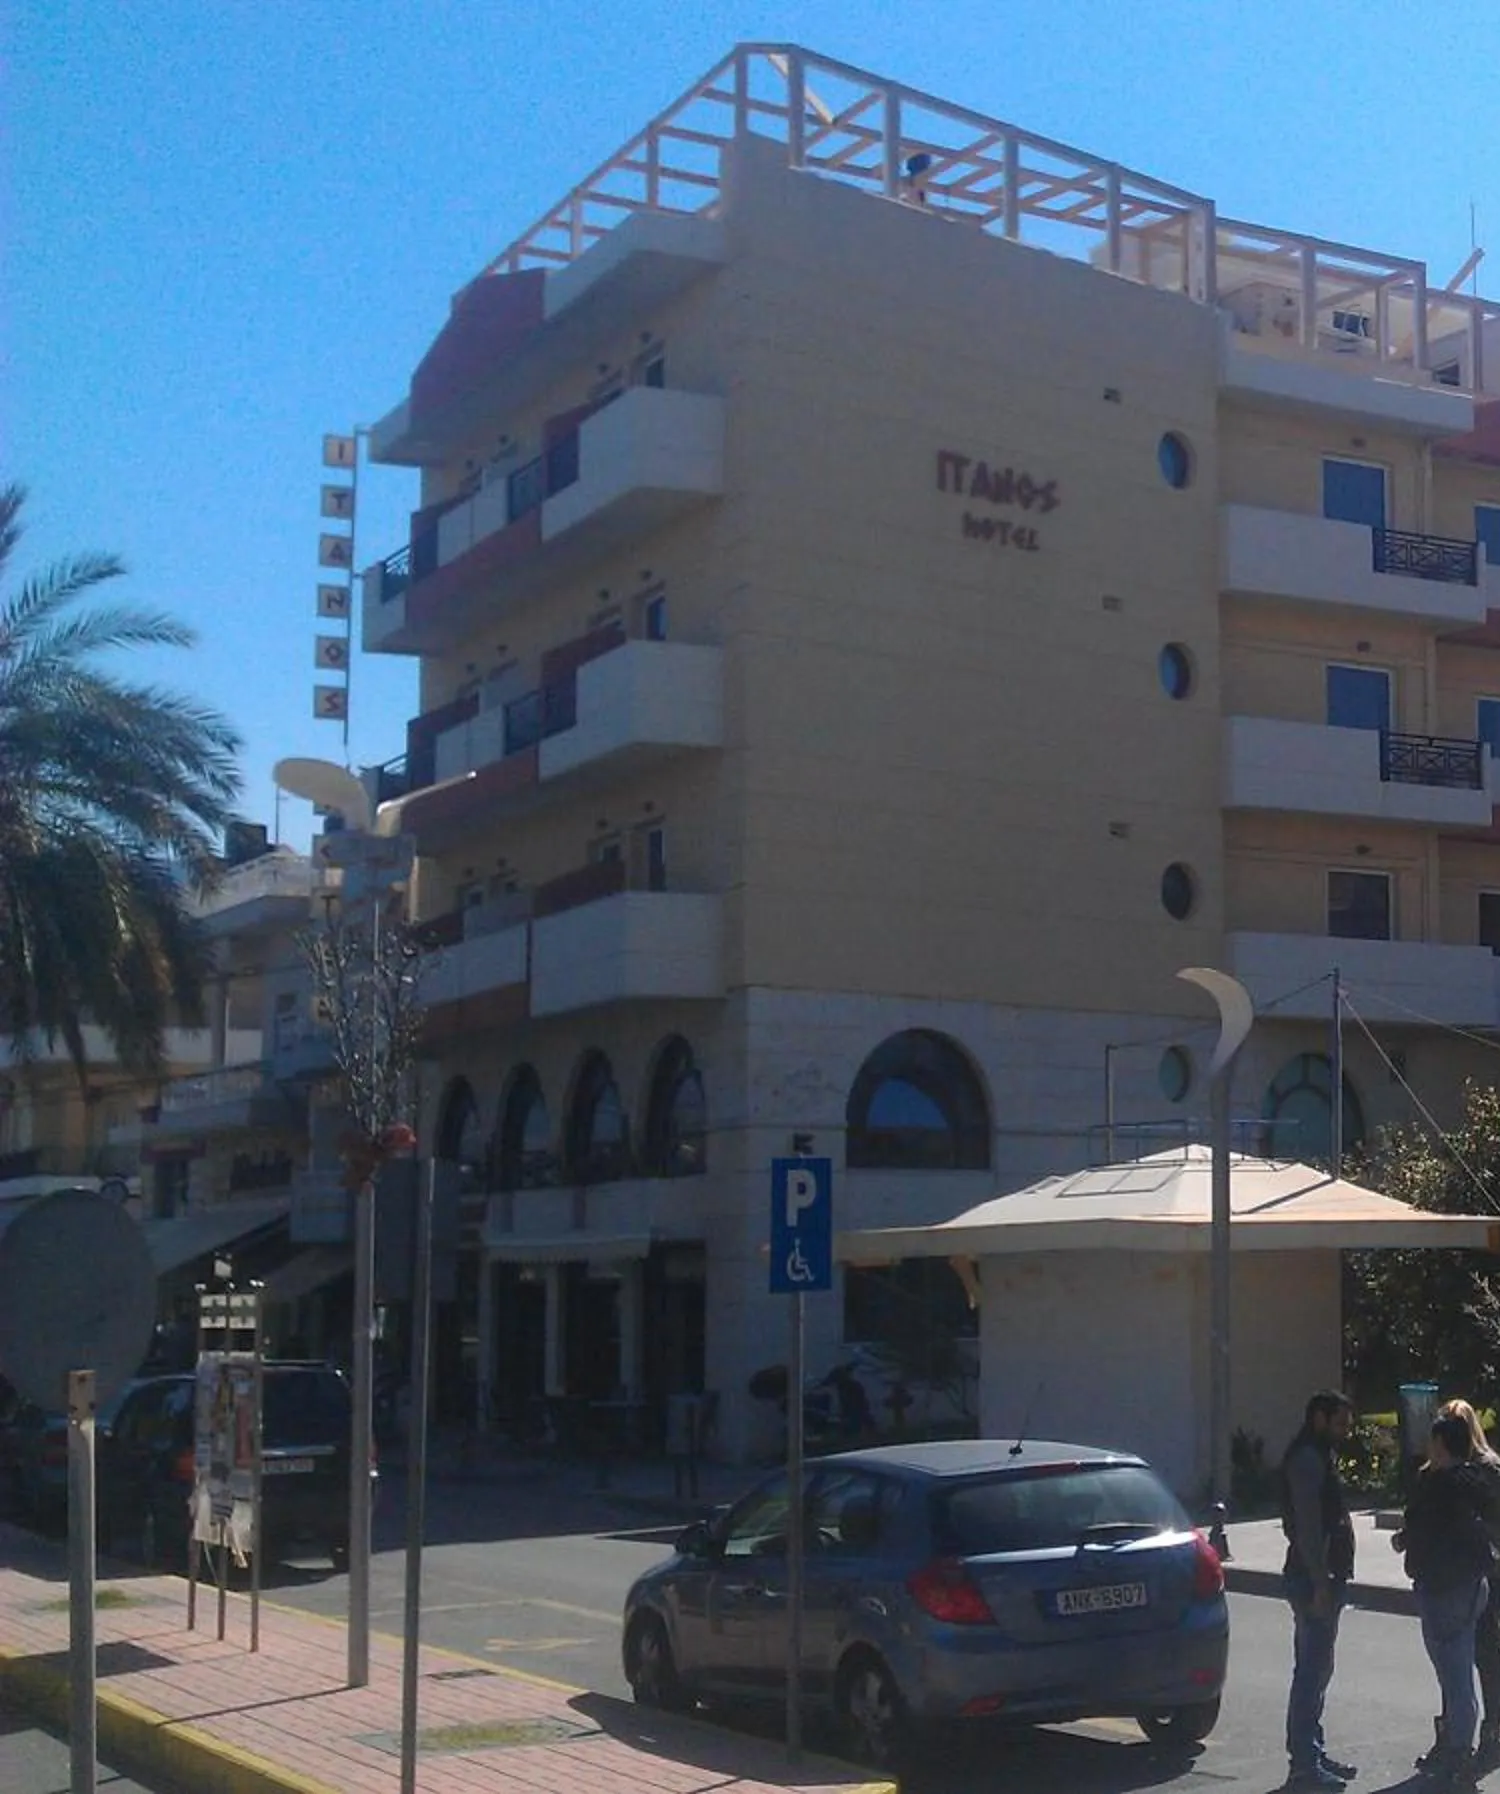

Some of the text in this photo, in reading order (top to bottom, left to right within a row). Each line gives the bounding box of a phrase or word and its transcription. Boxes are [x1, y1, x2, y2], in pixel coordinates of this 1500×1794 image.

[937, 449, 1061, 513] ITANOS
[324, 444, 347, 713] ITANOS
[786, 1169, 817, 1227] P
